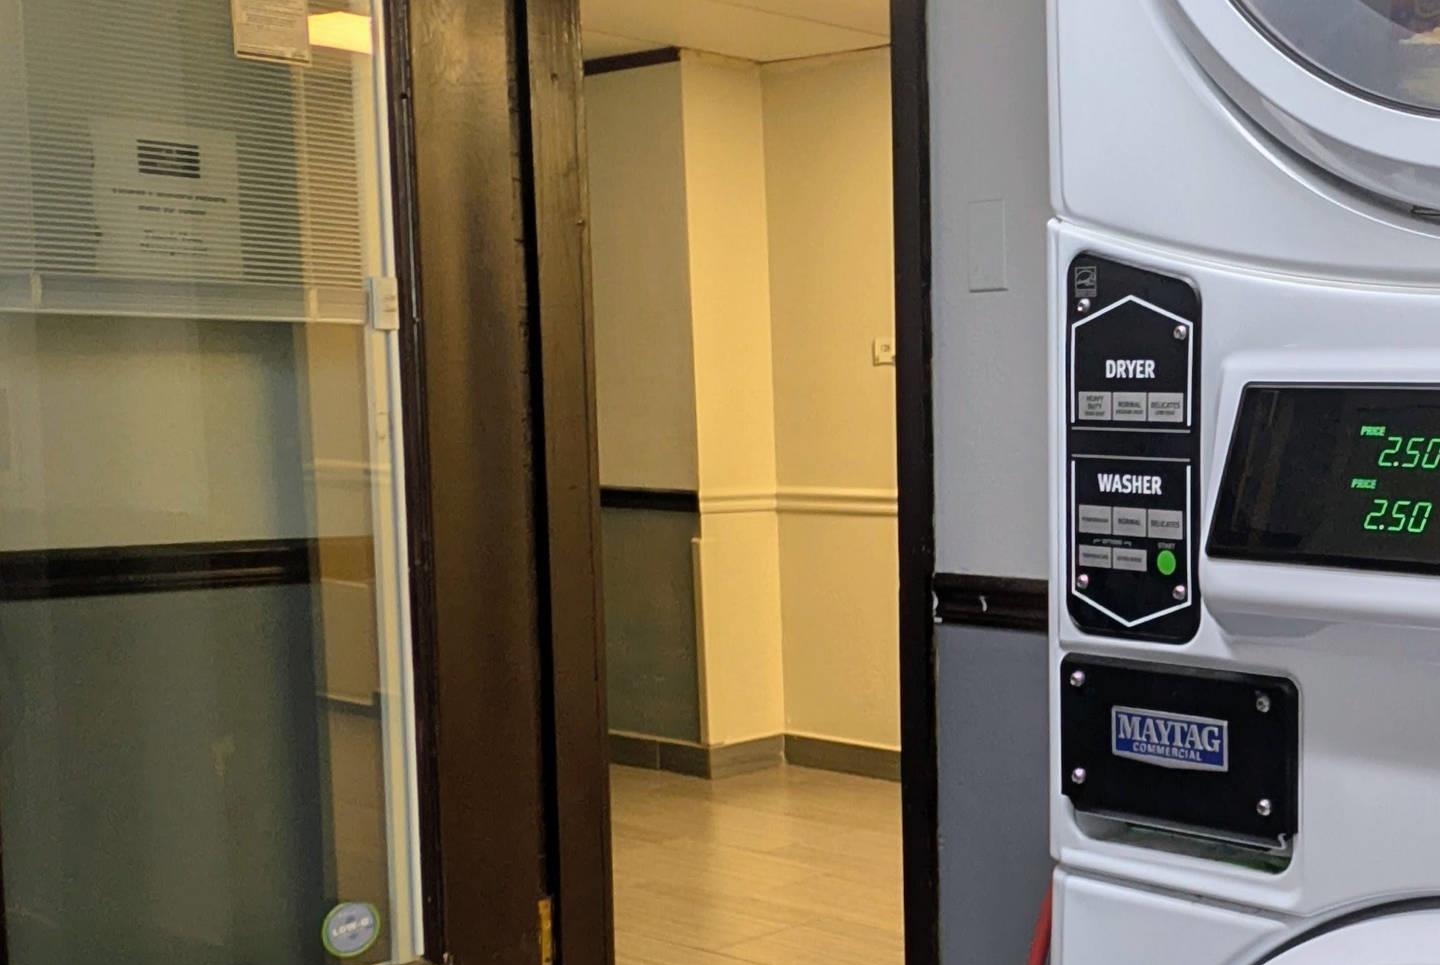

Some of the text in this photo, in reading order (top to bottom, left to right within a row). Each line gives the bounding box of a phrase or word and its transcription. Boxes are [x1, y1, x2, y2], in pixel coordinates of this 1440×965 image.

[1105, 359, 1155, 379] DRYER
[1360, 425, 1386, 436] PRICE
[1097, 473, 1162, 495] WASHER
[1351, 478, 1377, 489] PRICE
[1363, 499, 1432, 533] 2.50
[1118, 714, 1221, 753] MAYTAG
[1132, 741, 1203, 761] COMMERCIAL
